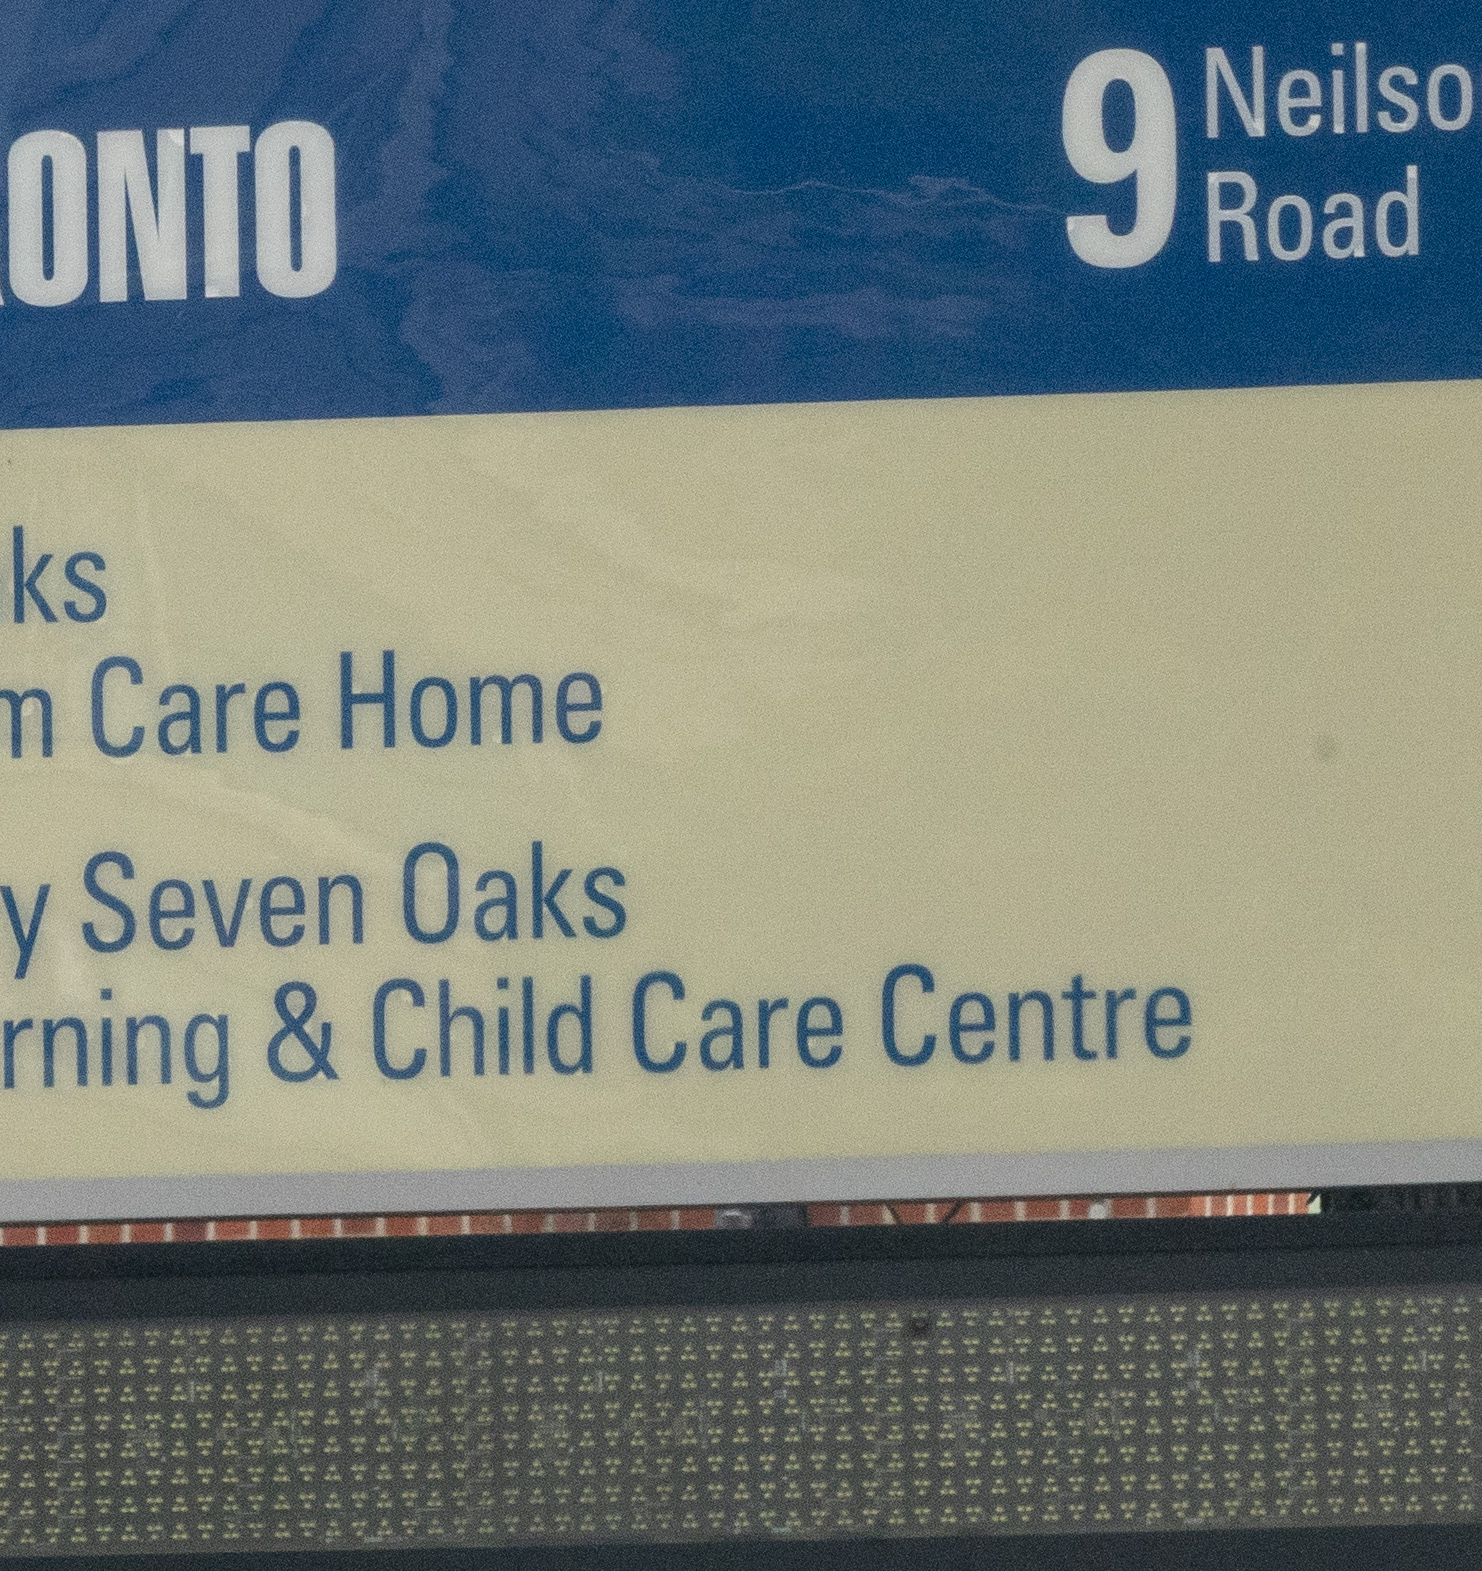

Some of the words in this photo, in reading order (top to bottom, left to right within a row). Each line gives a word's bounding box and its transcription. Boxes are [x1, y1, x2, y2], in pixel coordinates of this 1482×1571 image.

[1062, 48, 1177, 268] 9
[1206, 164, 1419, 262] Road
[91, 656, 301, 758] Care
[339, 650, 603, 750] Home
[81, 850, 364, 954] Seven
[402, 840, 628, 945] Oaks
[266, 981, 339, 1084] &
[372, 974, 594, 1081] Child
[631, 970, 844, 1074] Care
[881, 963, 1193, 1068] Centre
